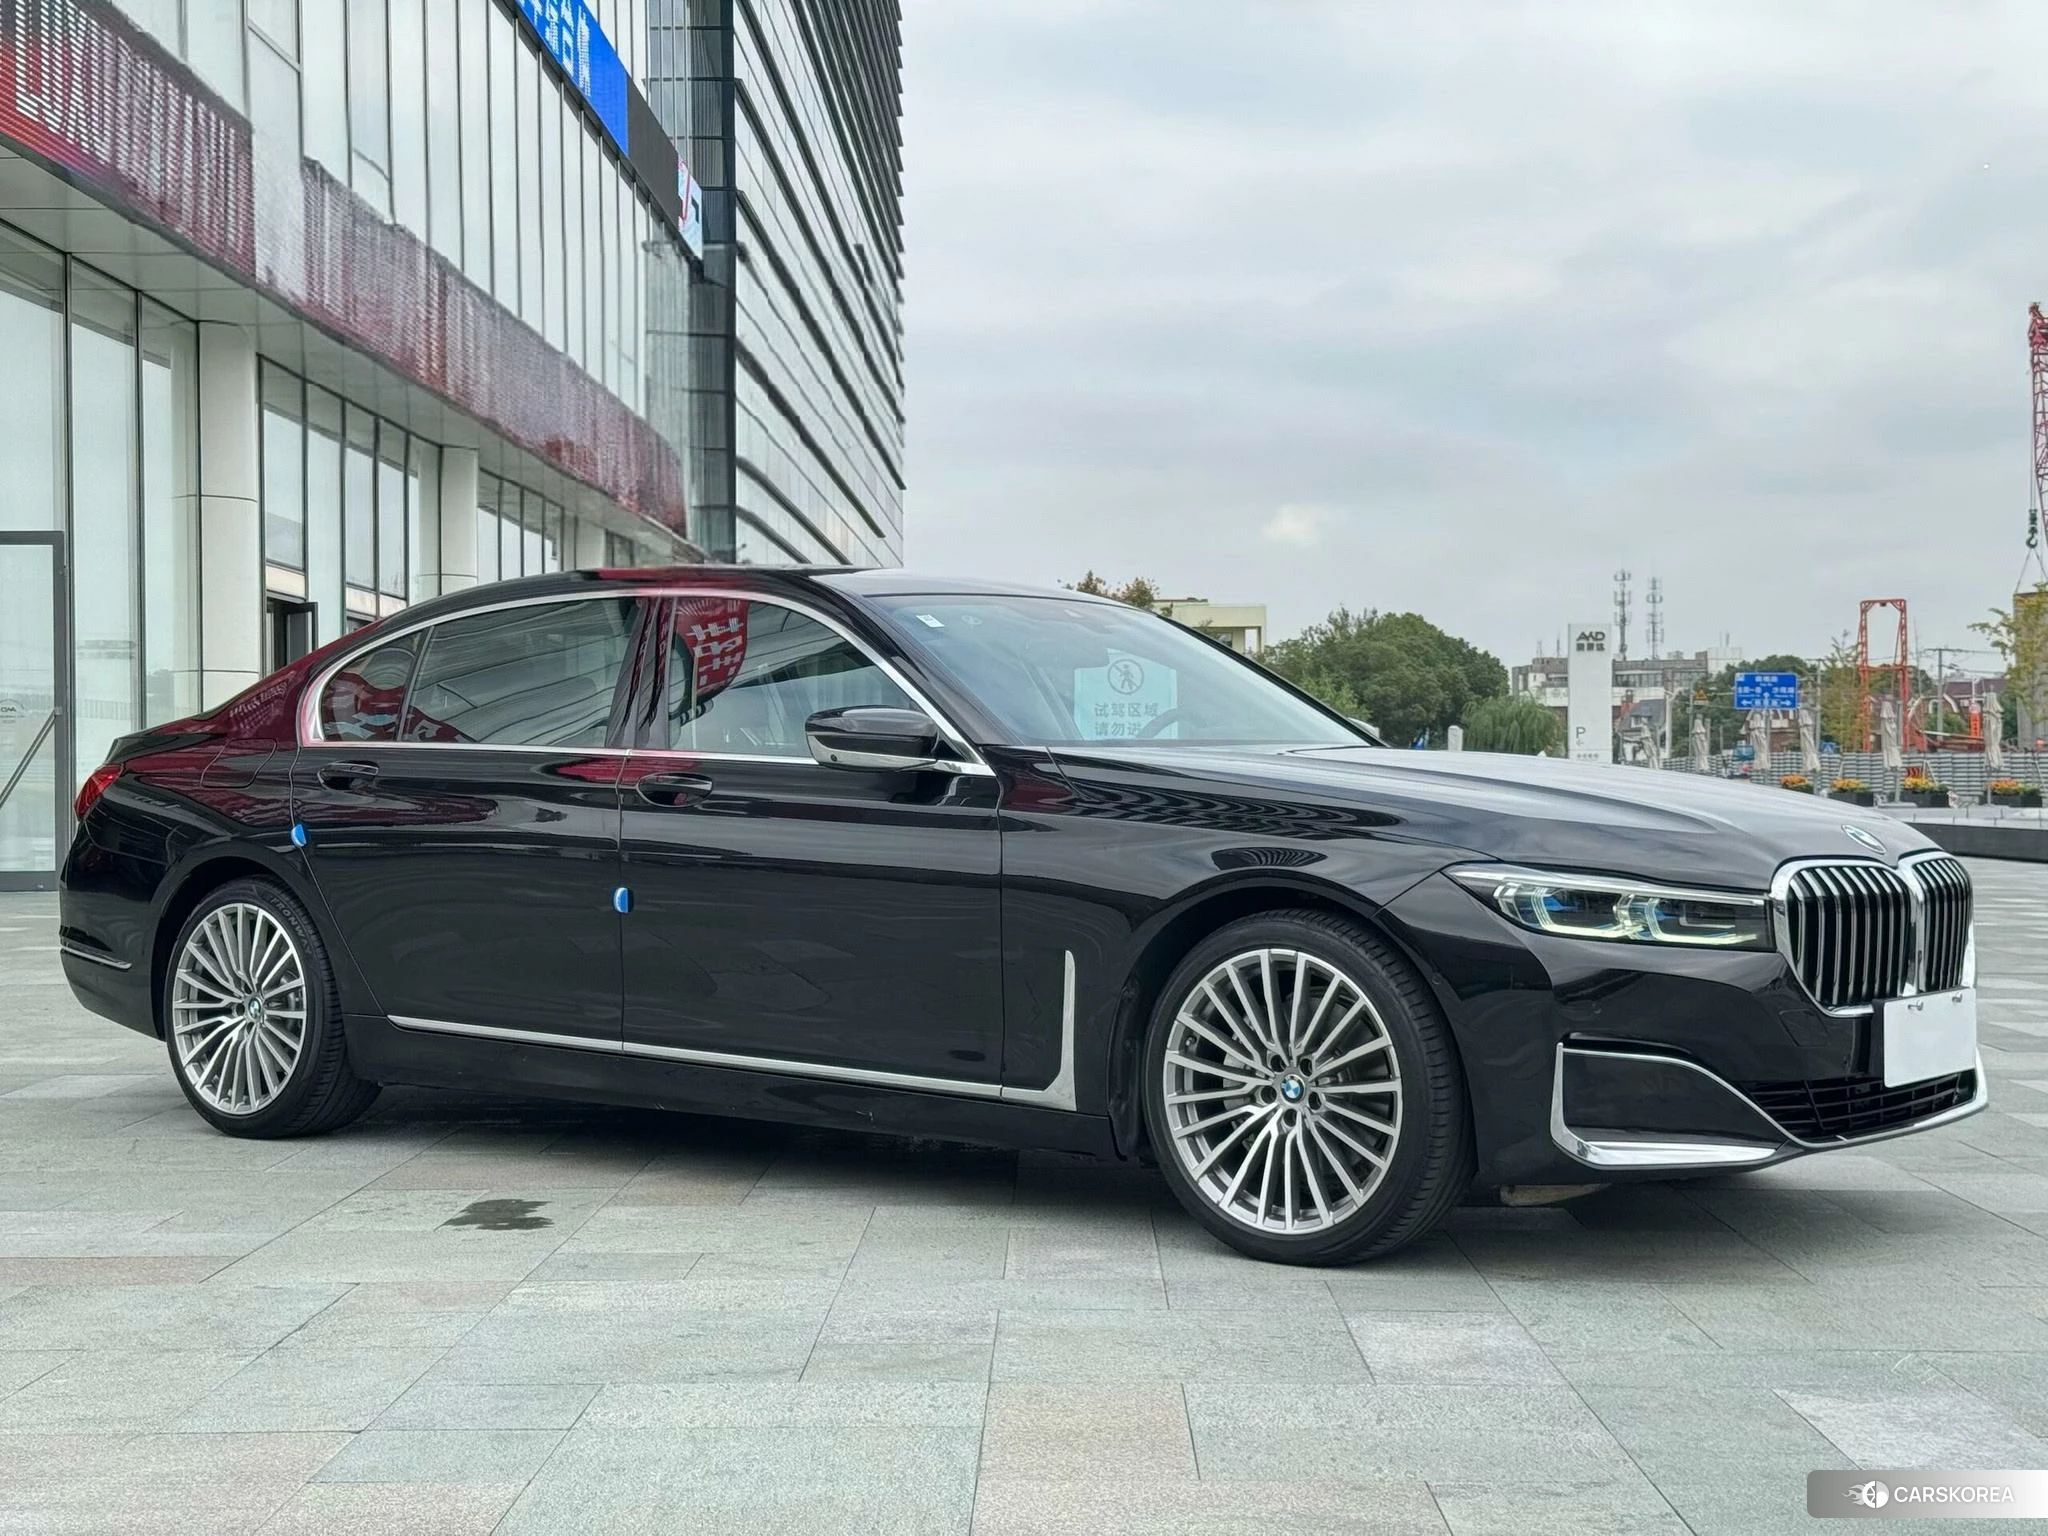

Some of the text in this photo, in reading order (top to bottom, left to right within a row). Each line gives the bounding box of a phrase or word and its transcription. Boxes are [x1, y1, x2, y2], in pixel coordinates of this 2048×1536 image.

[1095, 702, 1158, 718] 试驾区域
[1576, 727, 1586, 738] P
